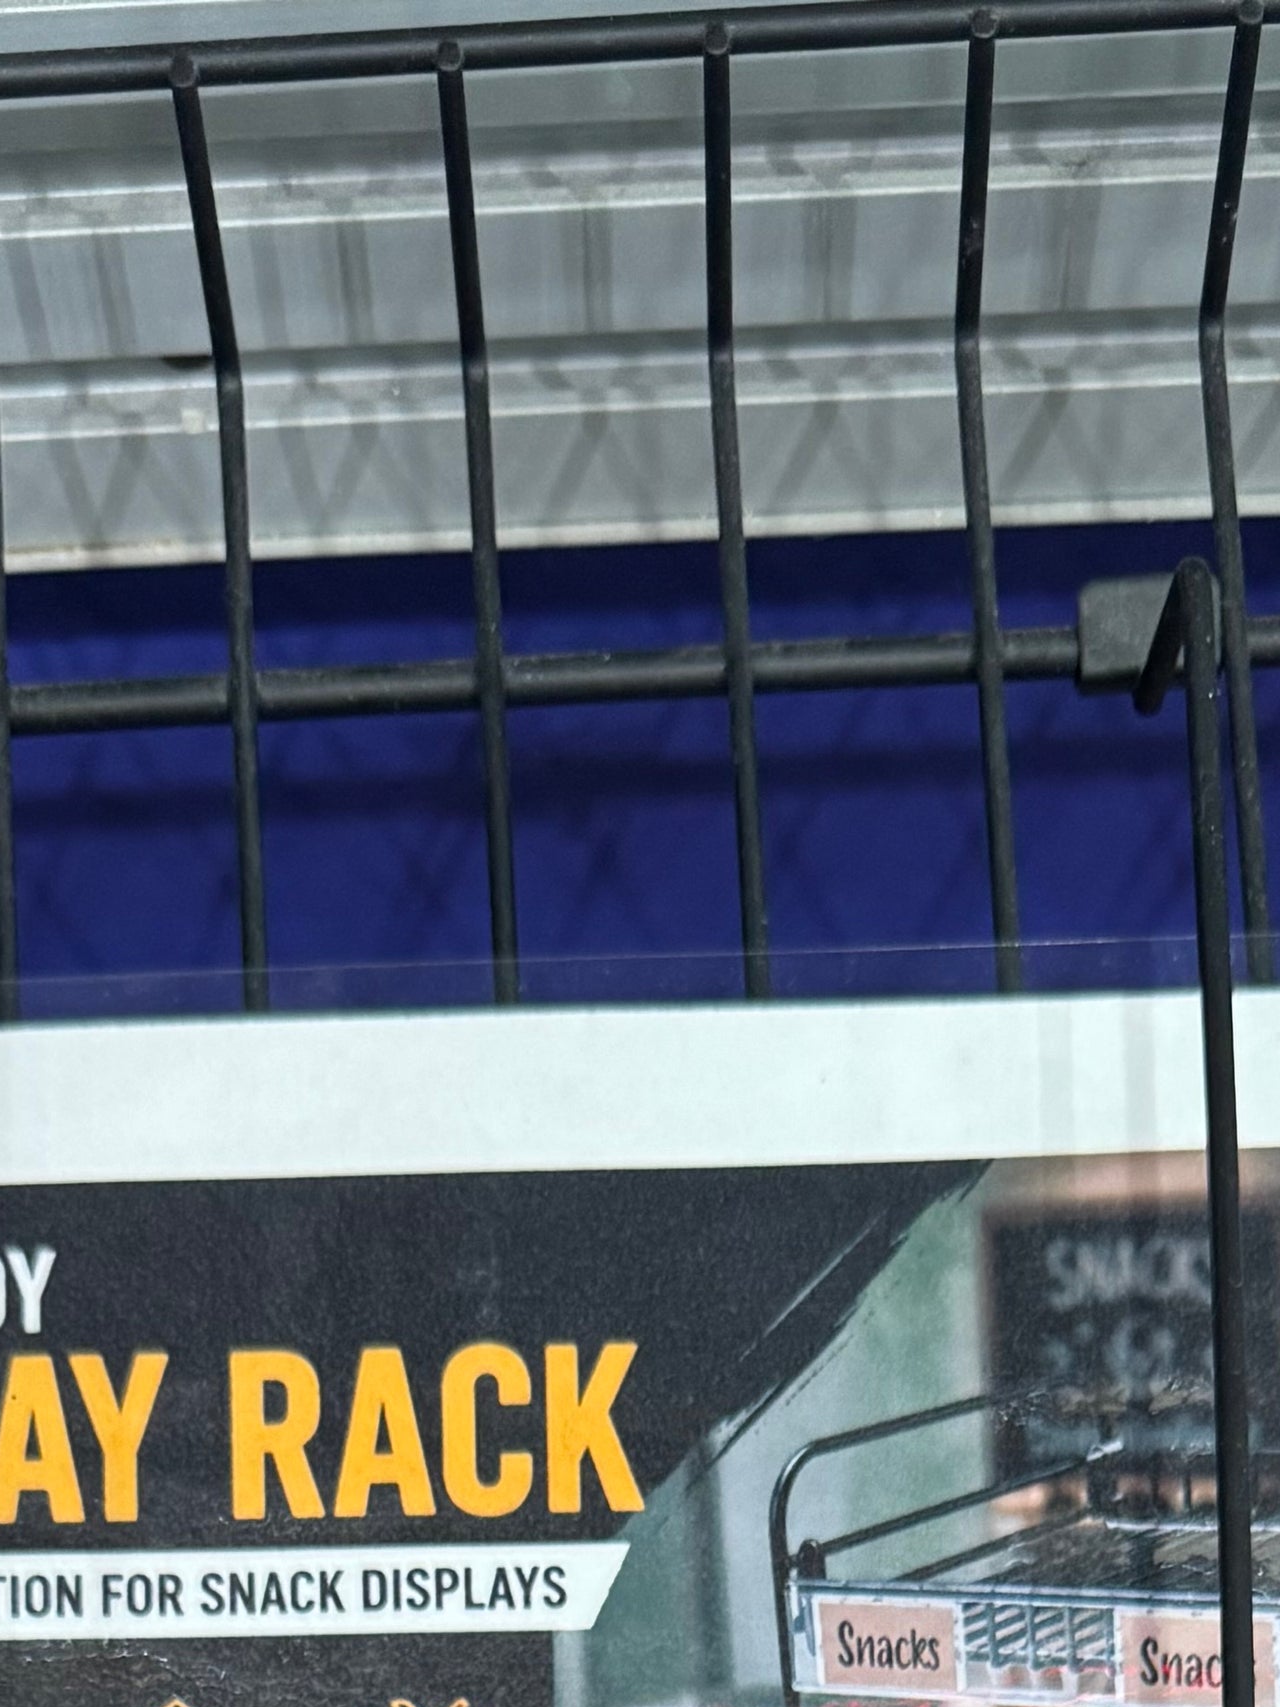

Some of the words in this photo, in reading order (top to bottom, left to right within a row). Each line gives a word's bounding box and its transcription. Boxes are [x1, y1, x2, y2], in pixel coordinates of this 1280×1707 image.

[230, 1342, 645, 1520] RACK
[101, 1572, 184, 1617] FOR
[200, 1568, 345, 1616] SNACK
[361, 1565, 568, 1612] DISPLAYS
[836, 1620, 941, 1672] Snacks
[1139, 1636, 1224, 1688] Snac
